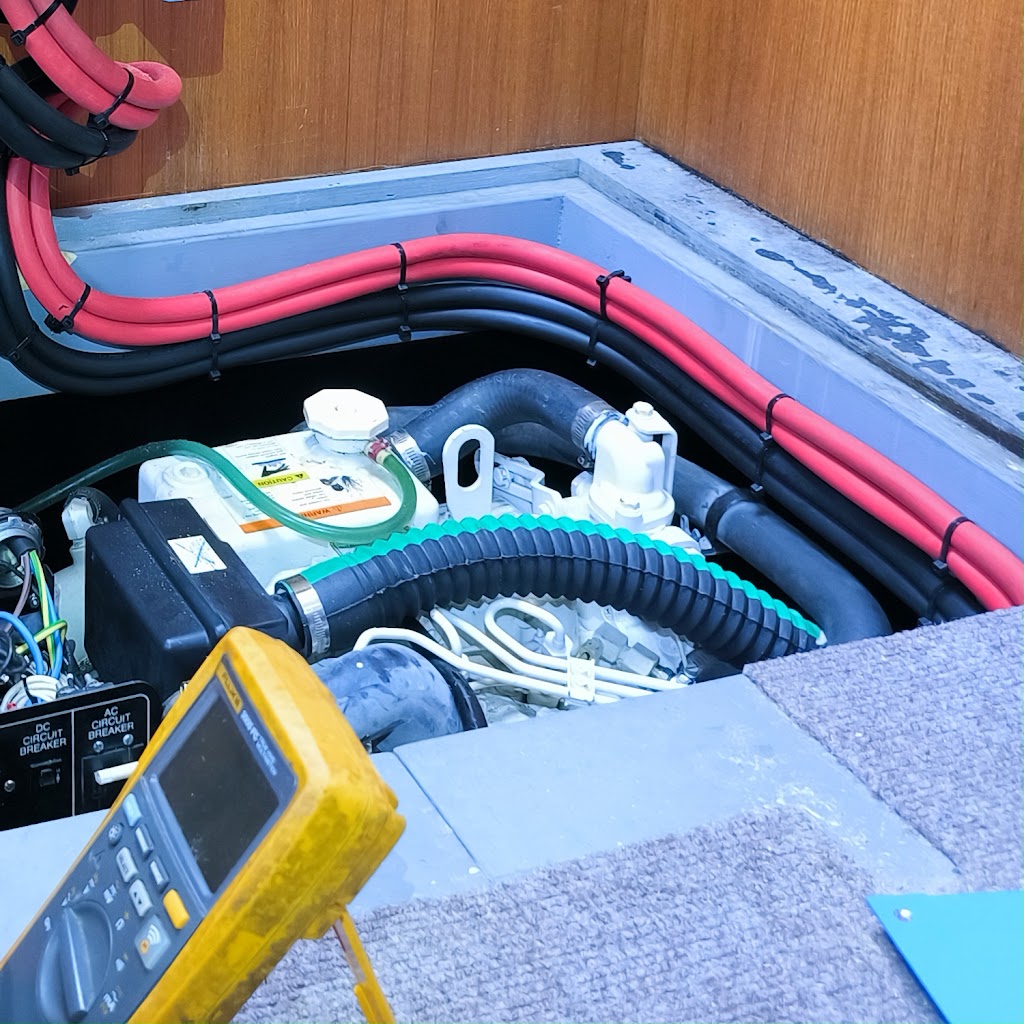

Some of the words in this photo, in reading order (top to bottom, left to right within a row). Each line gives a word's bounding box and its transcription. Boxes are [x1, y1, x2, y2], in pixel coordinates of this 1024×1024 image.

[257, 476, 294, 486] CAUTION
[103, 705, 119, 717] AC
[35, 721, 51, 734] DC
[91, 712, 131, 730] CIRCUIT
[22, 728, 64, 746] CIRCUIT
[88, 721, 135, 741] BREAKER
[19, 737, 67, 757] BREAKER
